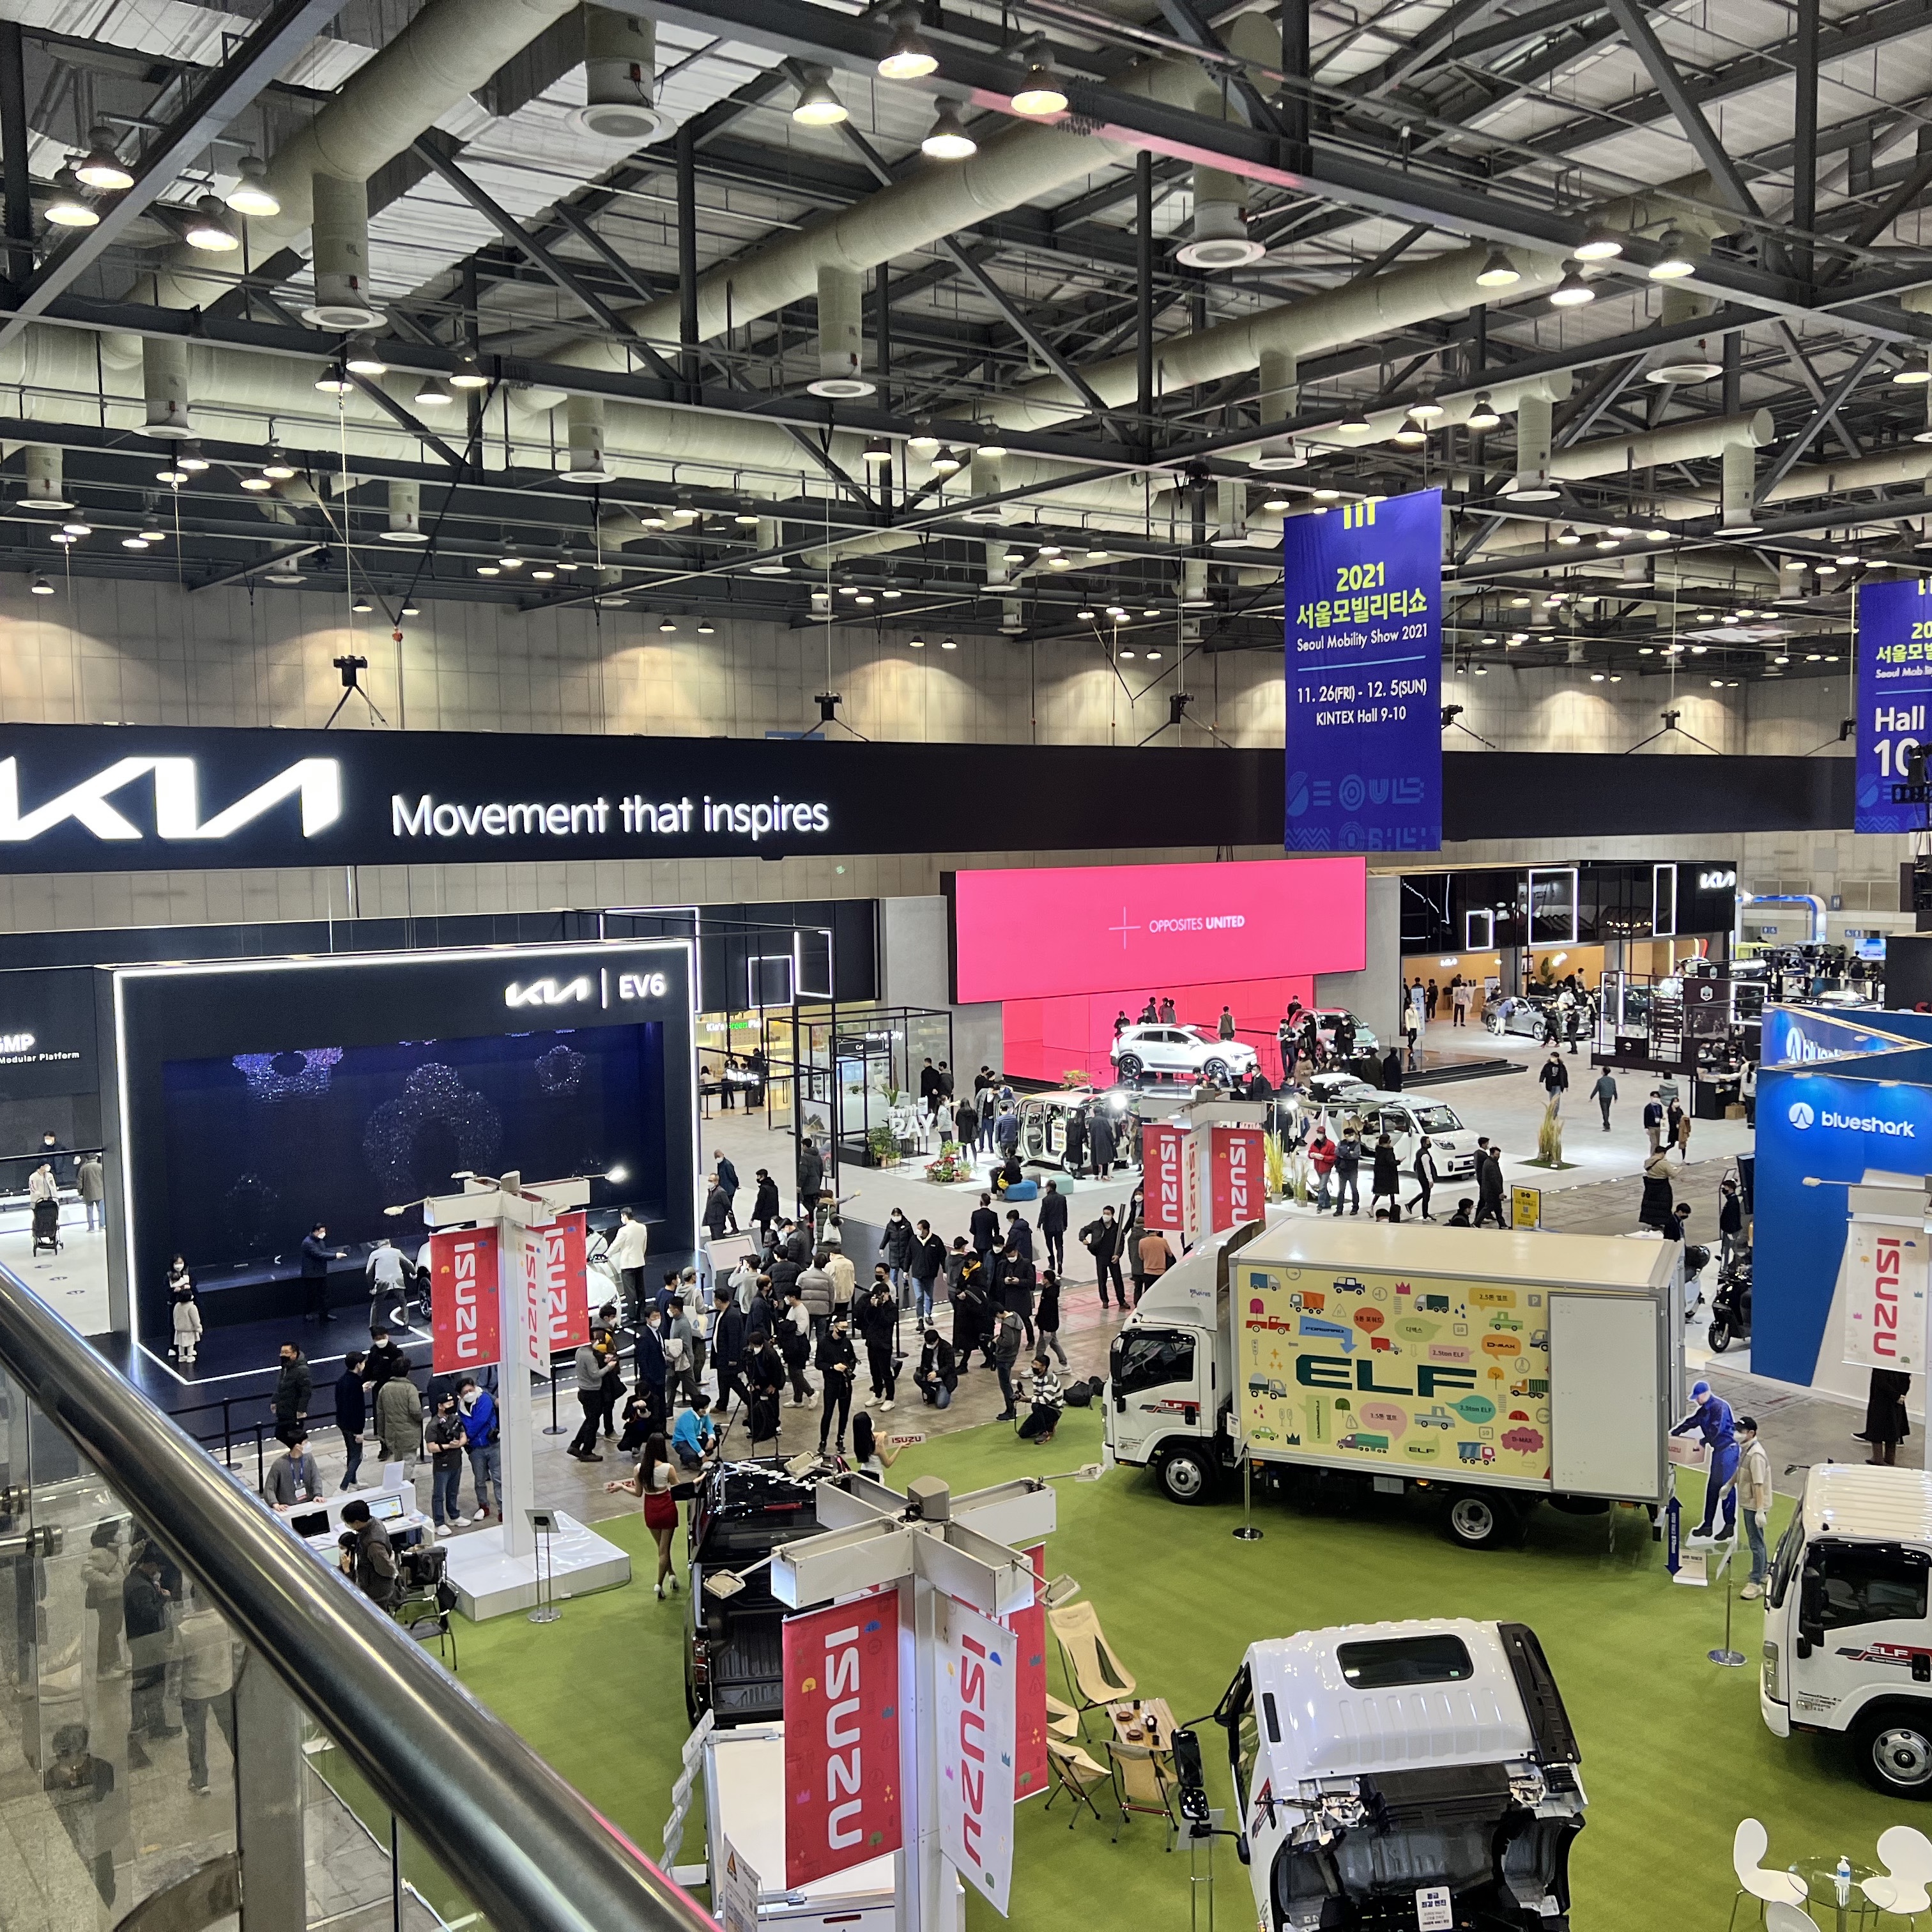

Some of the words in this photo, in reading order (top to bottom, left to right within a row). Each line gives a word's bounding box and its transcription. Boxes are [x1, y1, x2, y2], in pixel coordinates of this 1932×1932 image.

[1336, 562, 1385, 592] 2021
[1296, 587, 1428, 629] 서울모빌리티쇼
[1297, 634, 1324, 652] Seoul
[1327, 632, 1368, 649] Mobility
[1370, 629, 1399, 644] Show
[1402, 623, 1428, 640] 2021
[1319, 686, 1355, 703] 26(FRI)
[1390, 678, 1427, 698] 5(SUN)
[1316, 709, 1354, 726] KINTEX
[1357, 707, 1377, 723] Hall
[1381, 705, 1406, 722] 9-10
[1874, 705, 1925, 732] Hall
[0, 755, 341, 839] KIA
[391, 794, 610, 836] Movement
[618, 794, 693, 833] that
[703, 795, 831, 841] inspires
[1699, 870, 1736, 889] KIA
[1149, 917, 1203, 933] OPPOSITES
[1205, 915, 1245, 930] UNITED
[505, 977, 588, 1007] KIA
[618, 972, 666, 999] EV6
[39, 1052, 80, 1061] Platform
[1821, 1110, 1915, 1138] blueshark
[1160, 1135, 1178, 1223] ISUZU
[1229, 1138, 1248, 1227] ISUZU
[454, 1242, 478, 1359] ISUZU
[525, 1243, 538, 1360] ISUZU
[544, 1227, 568, 1340] ISUZU
[1873, 1238, 1901, 1357] ISUZU
[1296, 1354, 1477, 1398] ELF
[1866, 1645, 1909, 1657] ELF
[825, 1625, 863, 1850] ISUZU
[960, 1633, 986, 1868] ISUZU
